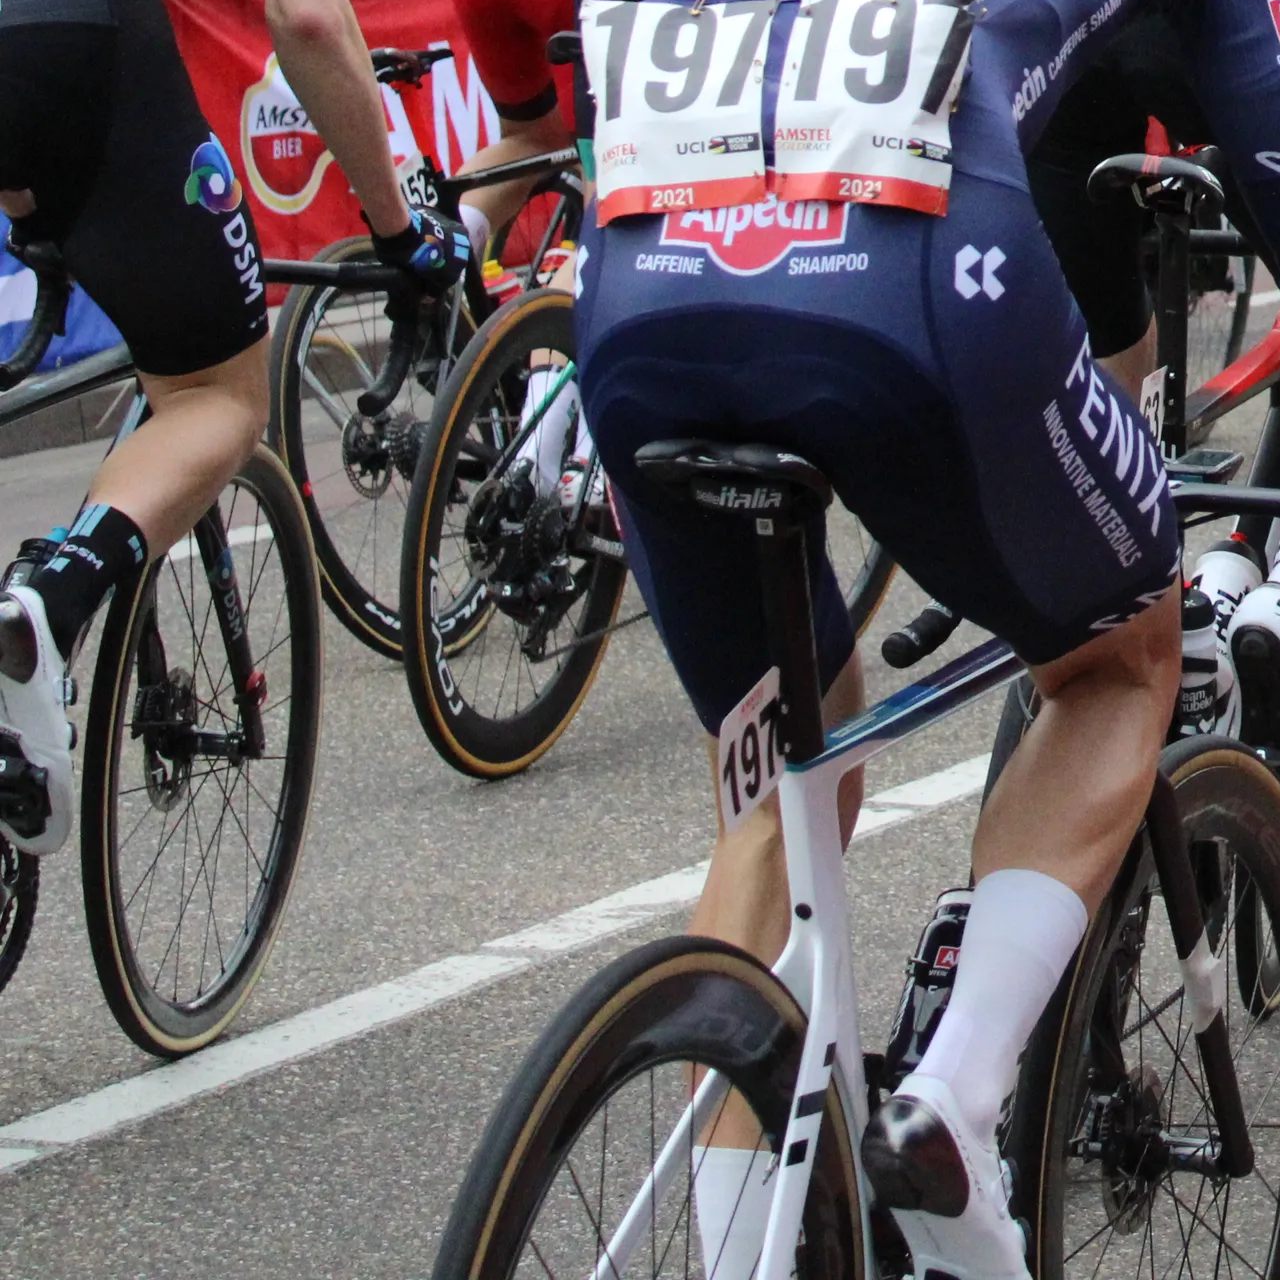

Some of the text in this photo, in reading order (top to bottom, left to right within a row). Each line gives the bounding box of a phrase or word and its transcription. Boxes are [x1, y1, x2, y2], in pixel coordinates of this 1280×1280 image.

[595, 0, 772, 122] 197
[728, 134, 754, 144] WORLD
[774, 128, 832, 141] AMSTEL
[872, 135, 903, 150] UCI
[272, 137, 303, 159] BIER
[602, 142, 638, 164] AMSTEL
[676, 140, 706, 156] UCI
[651, 177, 882, 208] 2021 2021
[680, 194, 830, 246] Alpecin
[222, 212, 265, 305] DSM
[635, 253, 869, 275] CAFFEINE SHAMPOO
[1065, 332, 1168, 538] FENIX
[719, 485, 782, 509] italia
[1043, 399, 1144, 569] INNOVATIVE MATERIALS
[64, 543, 105, 571] DSM
[723, 695, 778, 817] 197
